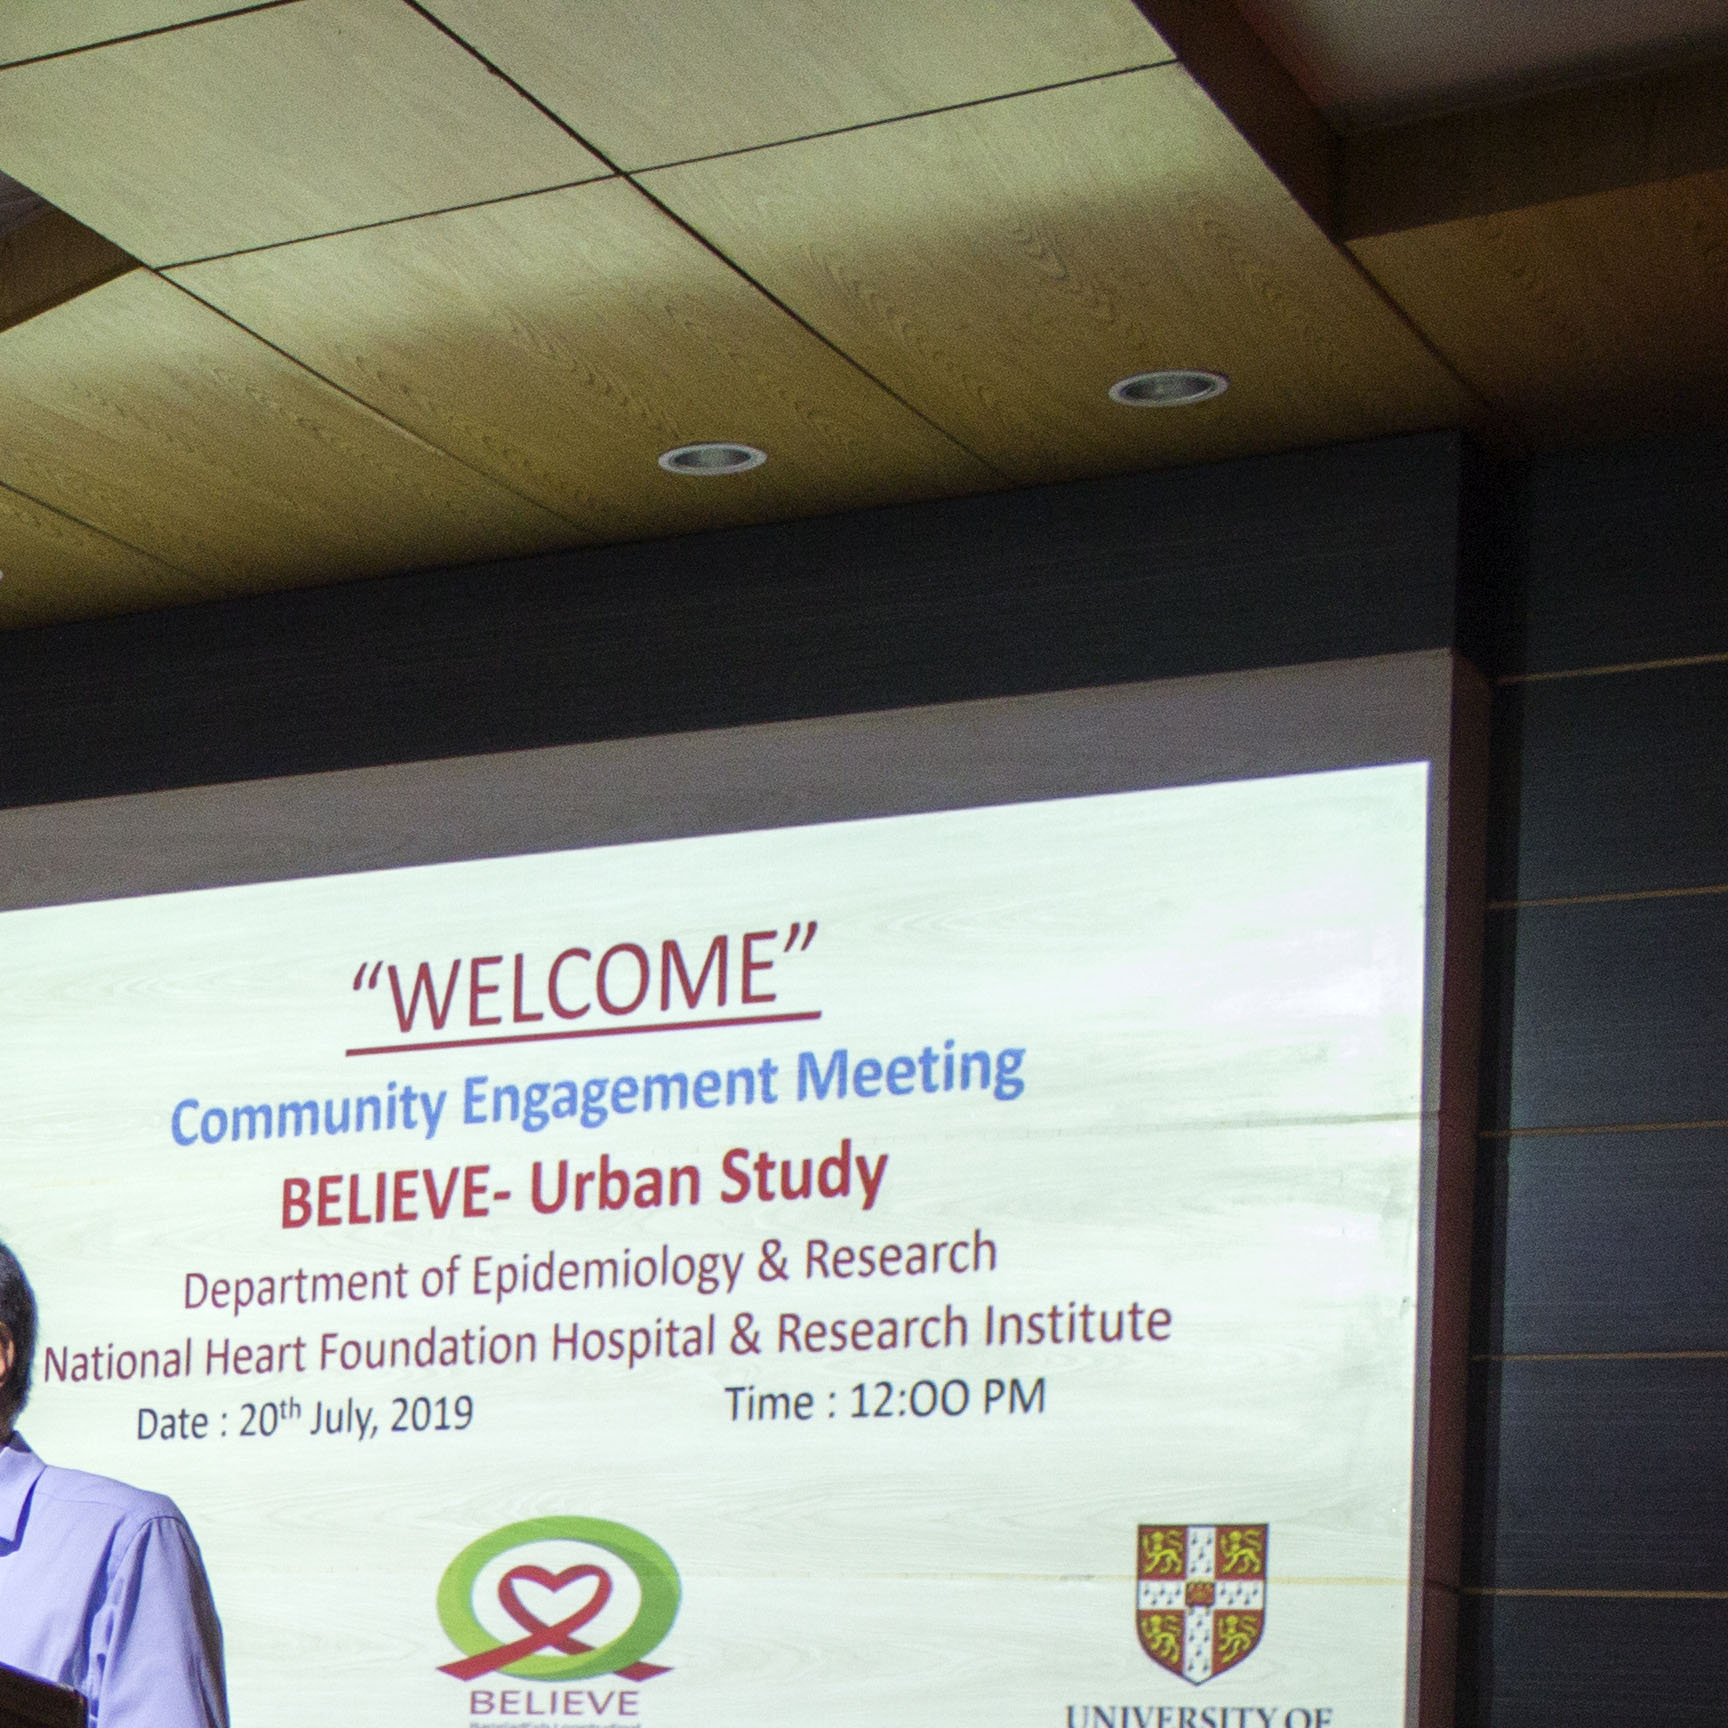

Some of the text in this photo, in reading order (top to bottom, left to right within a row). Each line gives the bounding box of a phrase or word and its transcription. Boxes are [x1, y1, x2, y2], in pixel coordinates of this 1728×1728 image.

[172, 1039, 1026, 1146] Community Engagement Meeting
[282, 1138, 888, 1228] BELIEVE- Urban Study
[185, 1229, 996, 1316] Department of Epidemiology & Research
[45, 1302, 1171, 1382] National Heart Foundation Hospital & Research Institute
[310, 1398, 377, 1441] July,
[392, 1395, 473, 1431] 2019
[984, 1377, 1045, 1413] PM
[470, 1690, 639, 1716] BELIEVE
